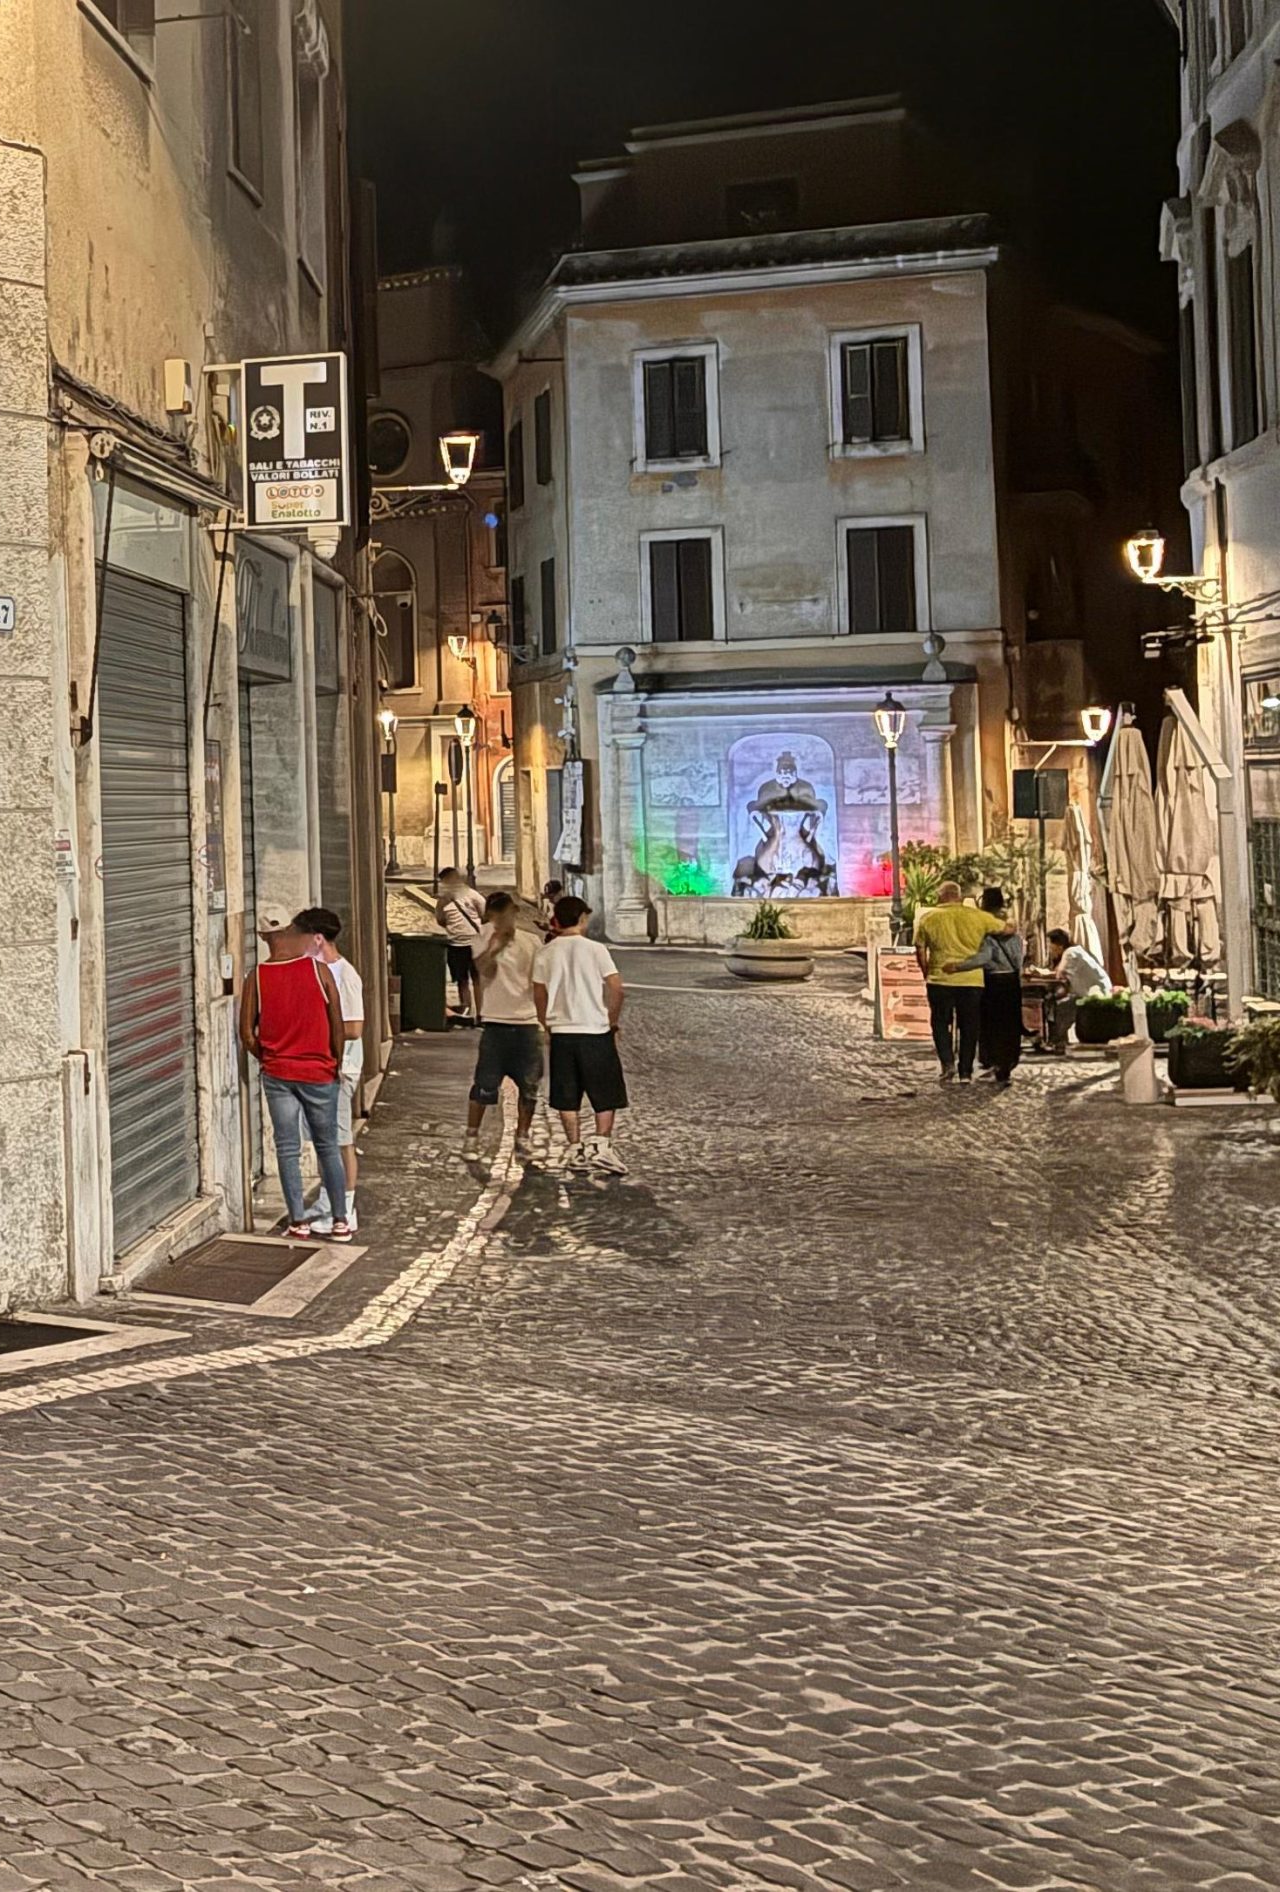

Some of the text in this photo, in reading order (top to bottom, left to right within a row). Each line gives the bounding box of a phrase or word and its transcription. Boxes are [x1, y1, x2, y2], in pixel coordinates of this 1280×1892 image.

[260, 361, 327, 460] T
[309, 410, 332, 419] RIV.
[309, 422, 328, 431] N.1
[249, 458, 340, 471] SALI E TABACCHI
[250, 469, 339, 482] VALORI BOLLATI
[267, 485, 324, 499] LOTTO
[271, 509, 321, 519] Enalotto
